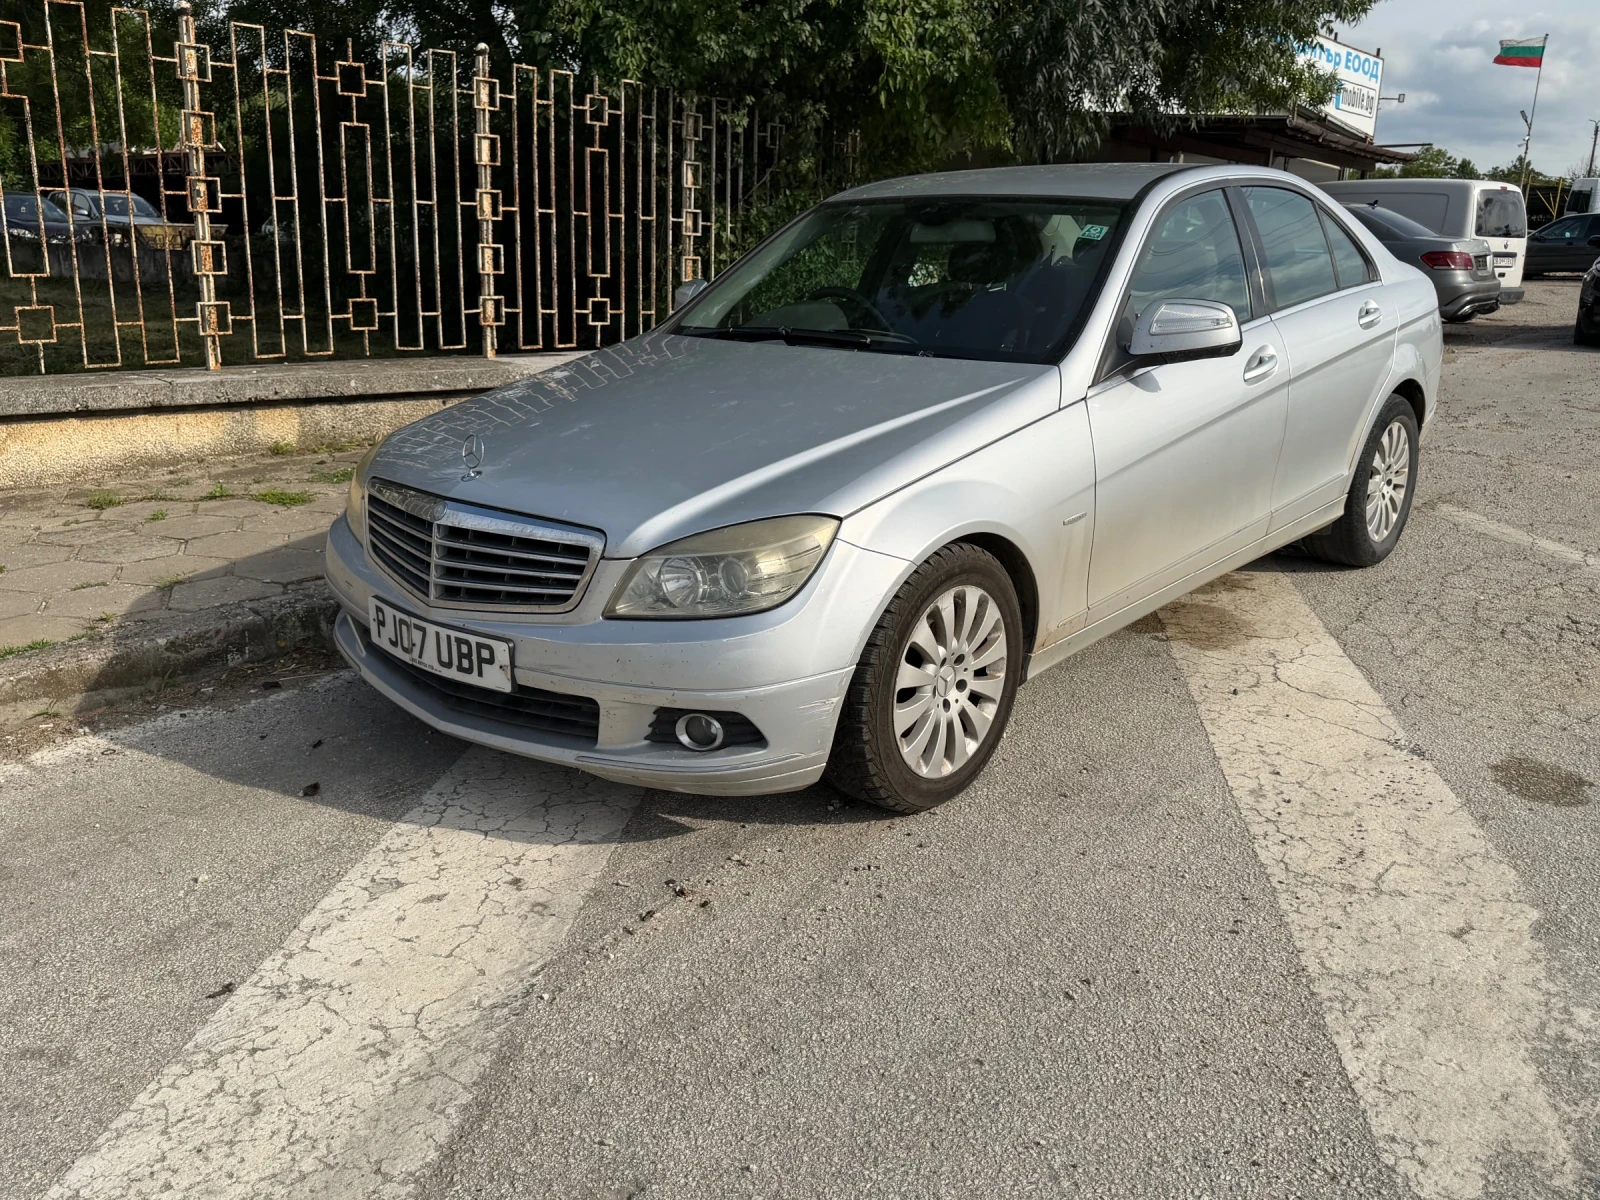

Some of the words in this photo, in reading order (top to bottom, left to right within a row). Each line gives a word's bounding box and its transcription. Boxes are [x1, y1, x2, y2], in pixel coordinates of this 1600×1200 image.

[1344, 50, 1380, 84] ЕООД
[1341, 86, 1374, 115] mobile.bg
[375, 604, 426, 659] PJ07
[435, 630, 495, 678] UBP
